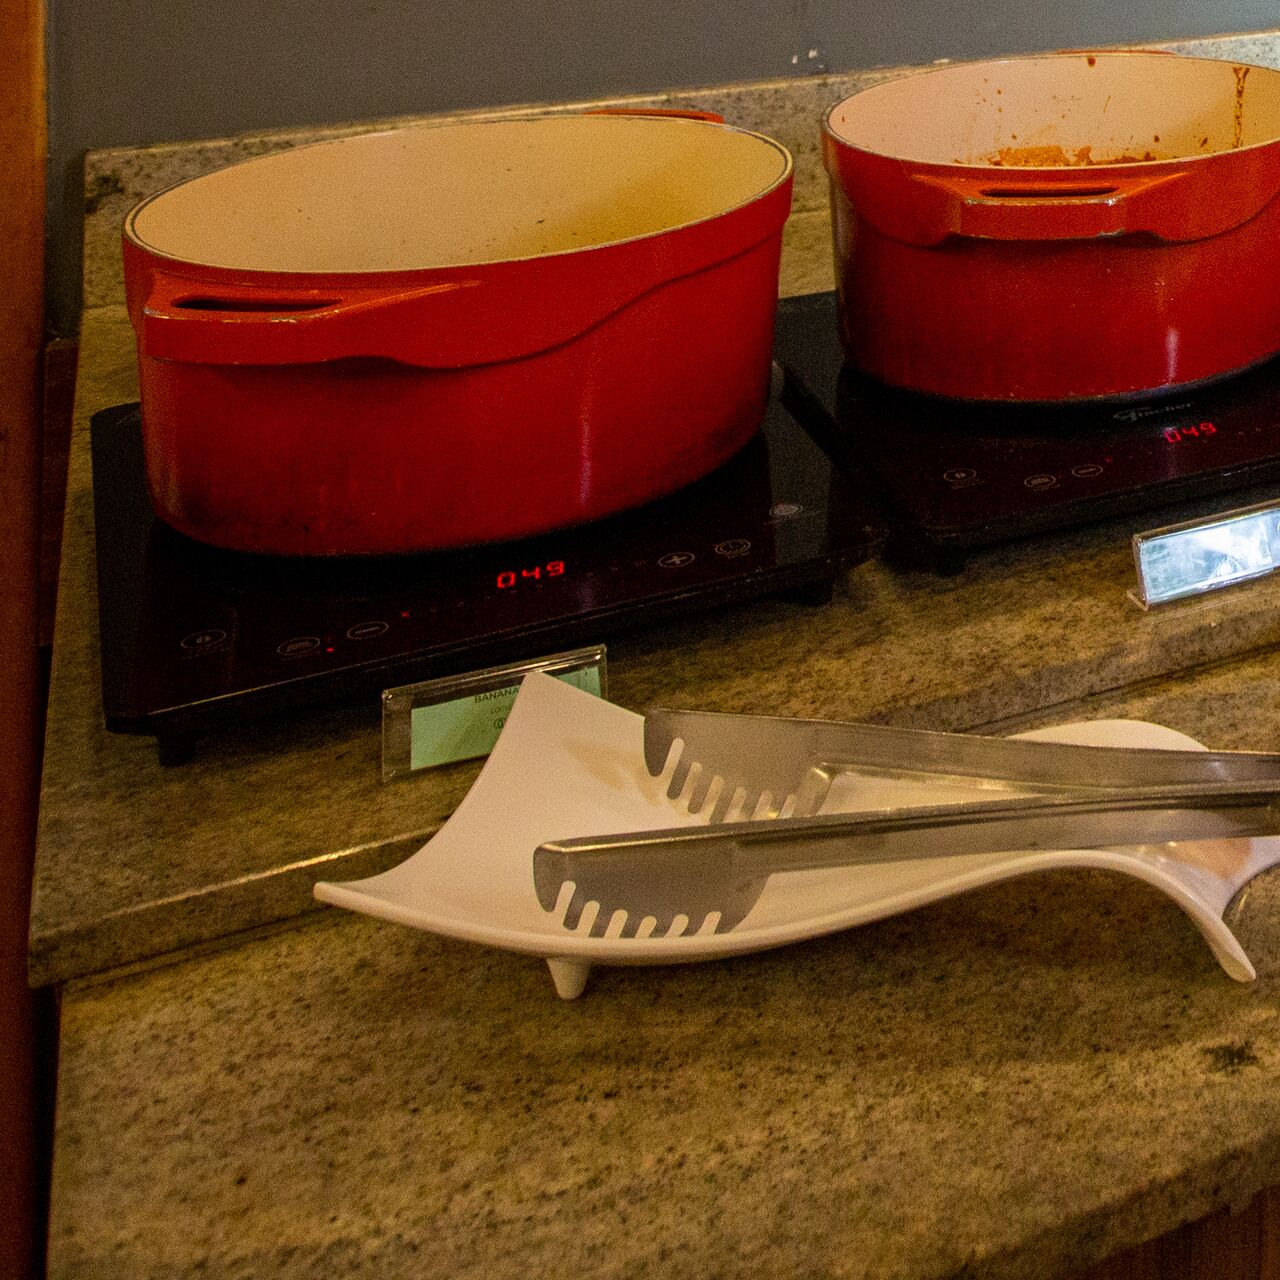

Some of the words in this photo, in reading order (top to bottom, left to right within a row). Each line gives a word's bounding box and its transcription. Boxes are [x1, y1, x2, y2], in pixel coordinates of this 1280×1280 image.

[1163, 422, 1217, 443] 049
[497, 561, 565, 589] 049
[474, 686, 520, 704] BANANA
